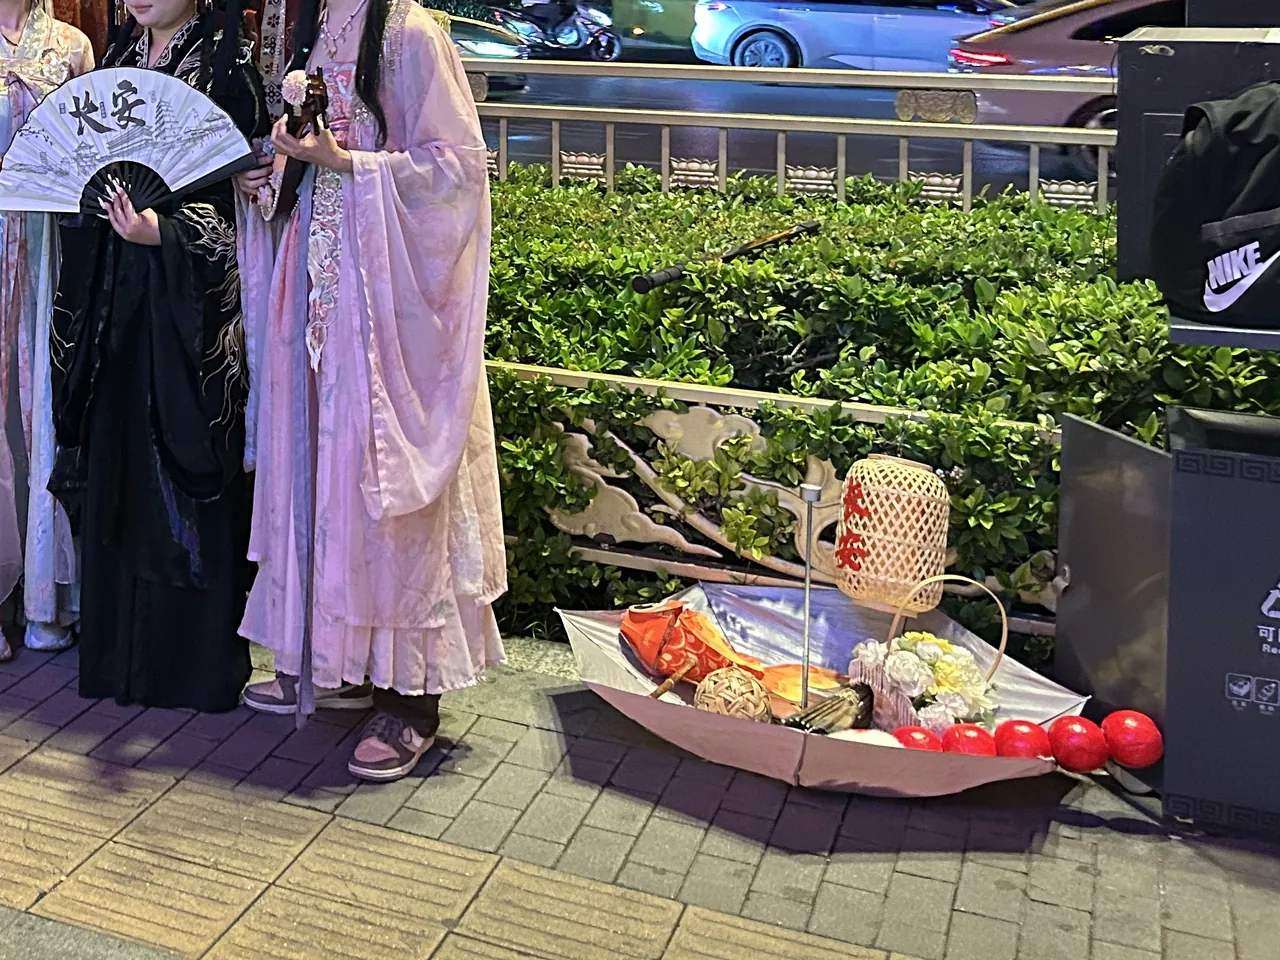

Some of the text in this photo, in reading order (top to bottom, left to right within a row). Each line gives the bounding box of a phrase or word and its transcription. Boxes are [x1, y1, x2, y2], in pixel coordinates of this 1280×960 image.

[1206, 241, 1261, 290] NIKE
[1257, 625, 1280, 643] 可
[1261, 643, 1280, 654] Re
